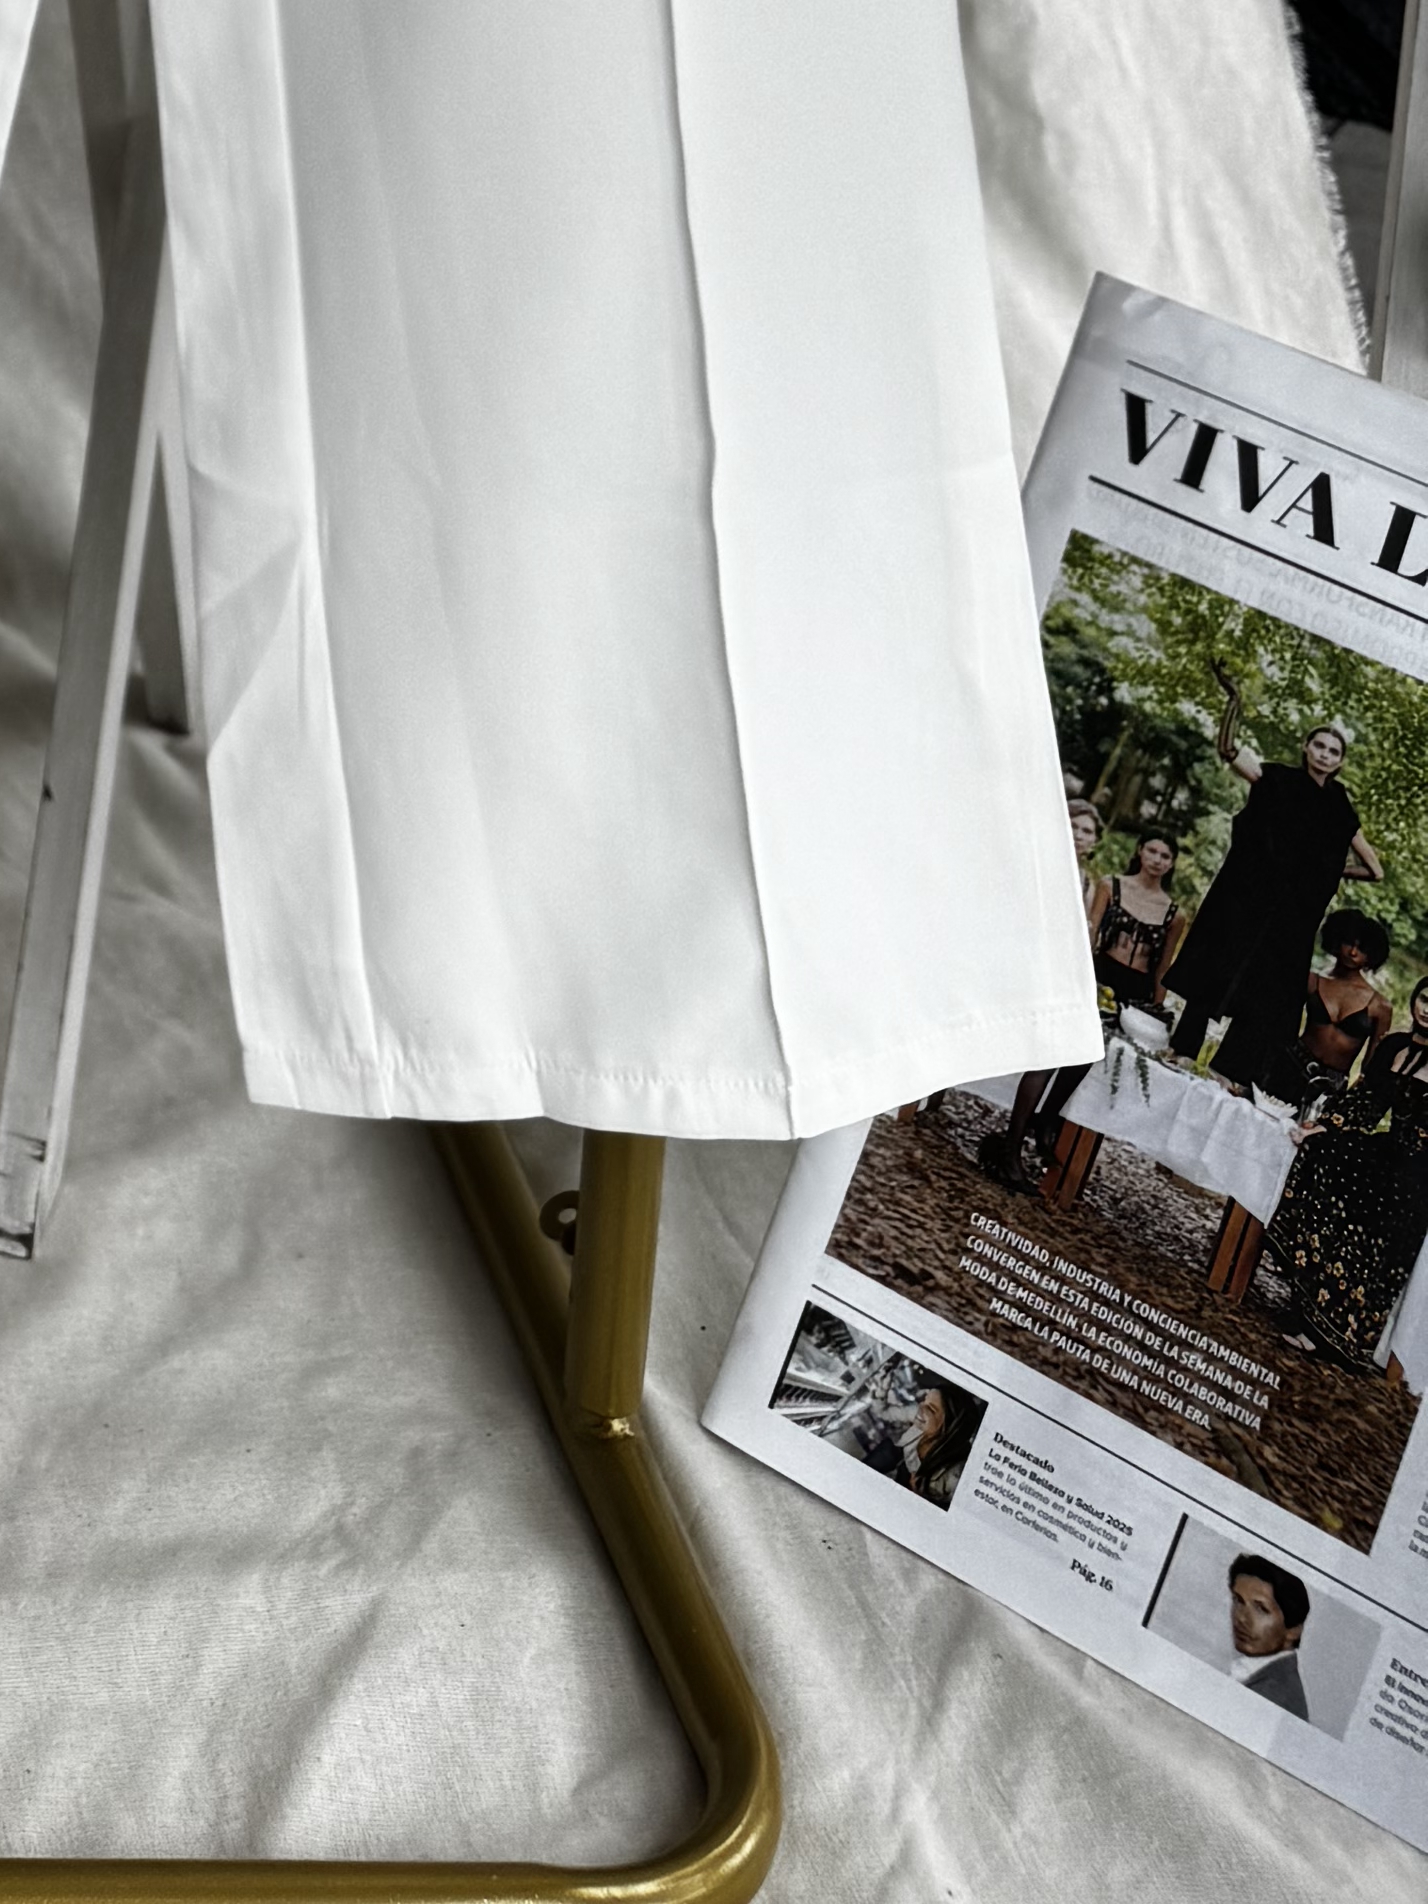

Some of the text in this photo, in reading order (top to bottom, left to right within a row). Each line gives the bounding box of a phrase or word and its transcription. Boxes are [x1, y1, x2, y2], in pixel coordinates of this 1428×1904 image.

[1120, 387, 1340, 552] VIVA
[958, 1255, 1261, 1431] MODA DE MEDELLÍN. LA ECONOMÍA COLABORATIVA
[966, 1235, 1269, 1410] CONVERGEN EN ESTA EDICIÓN DE LA SEMANA DE LA
[970, 1212, 1280, 1390] CREATIVIDAD, INDUSTRIA Y CONCIENCIA AMBIENTAL
[989, 1297, 1211, 1430] MARCA LA PAUTA DE UNA NUEVA ERA.
[988, 1447, 1133, 1537] La Feria Belleza y Salud 2025
[993, 1432, 1055, 1473] Destacado
[978, 1475, 1021, 1505] servicios
[1022, 1501, 1036, 1513] en
[1087, 1538, 1096, 1549] y
[983, 1461, 1004, 1479] trae
[1051, 1501, 1066, 1514] en
[1066, 1510, 1118, 1545] productos
[1120, 1541, 1128, 1552] y
[1000, 1504, 1014, 1516] en
[1070, 1558, 1113, 1591] Pág. 16
